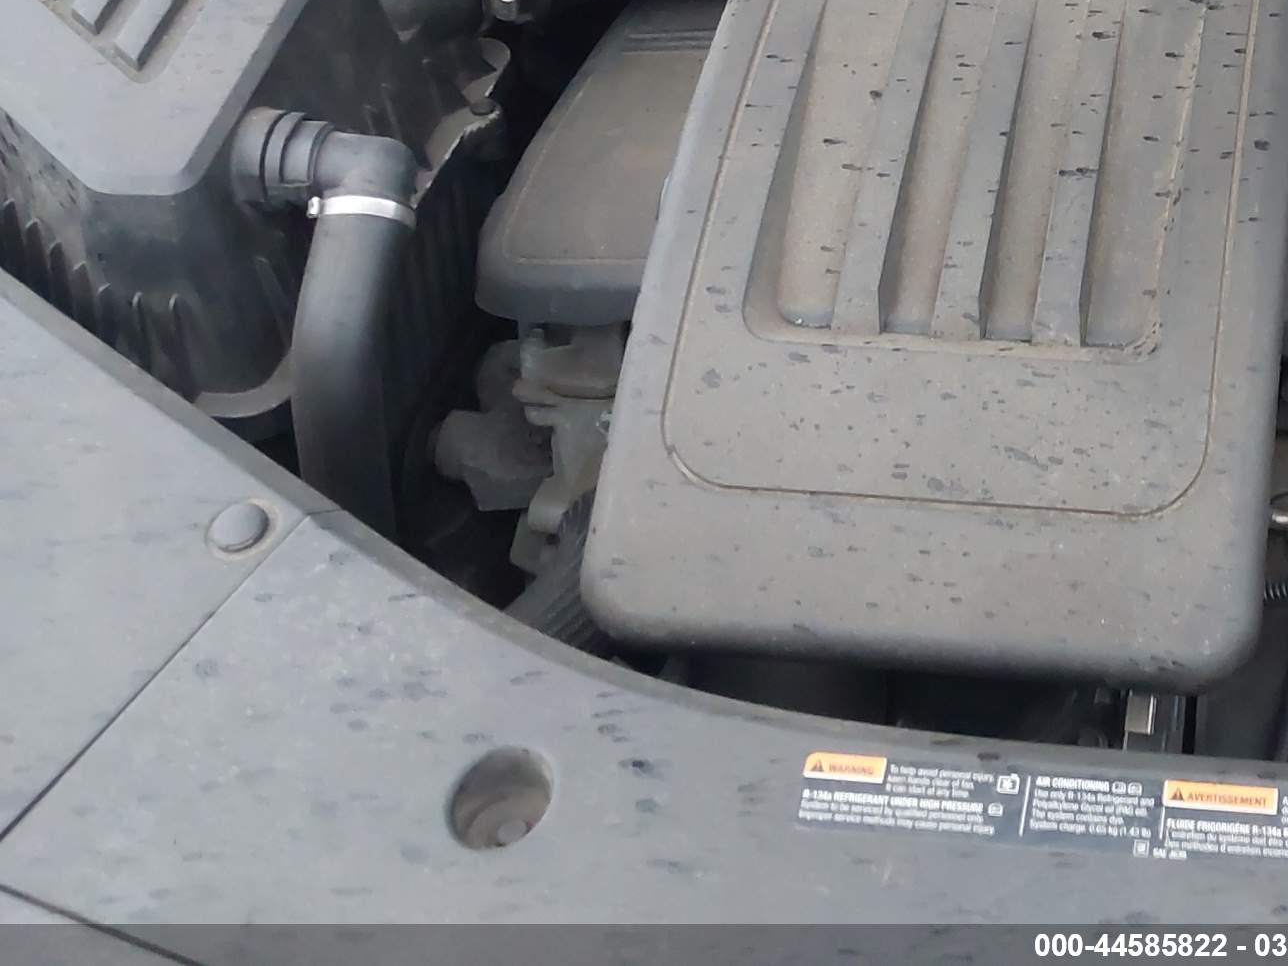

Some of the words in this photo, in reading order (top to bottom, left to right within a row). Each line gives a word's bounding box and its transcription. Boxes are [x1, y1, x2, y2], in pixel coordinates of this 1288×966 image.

[829, 764, 874, 775] WARNING
[939, 770, 971, 781] personal
[1036, 776, 1051, 788] AIR
[1052, 778, 1110, 793] CONDITIONING
[802, 789, 832, 802] R-134a
[833, 791, 889, 806] REFRIGERANT
[890, 796, 918, 808] UNDER
[919, 798, 940, 810] HIGH
[941, 800, 984, 814] PRESSURE
[1187, 792, 1267, 809] AVERTISSEMENT
[1167, 818, 1196, 832] FLUIDE
[1252, 824, 1282, 837] R-134a
